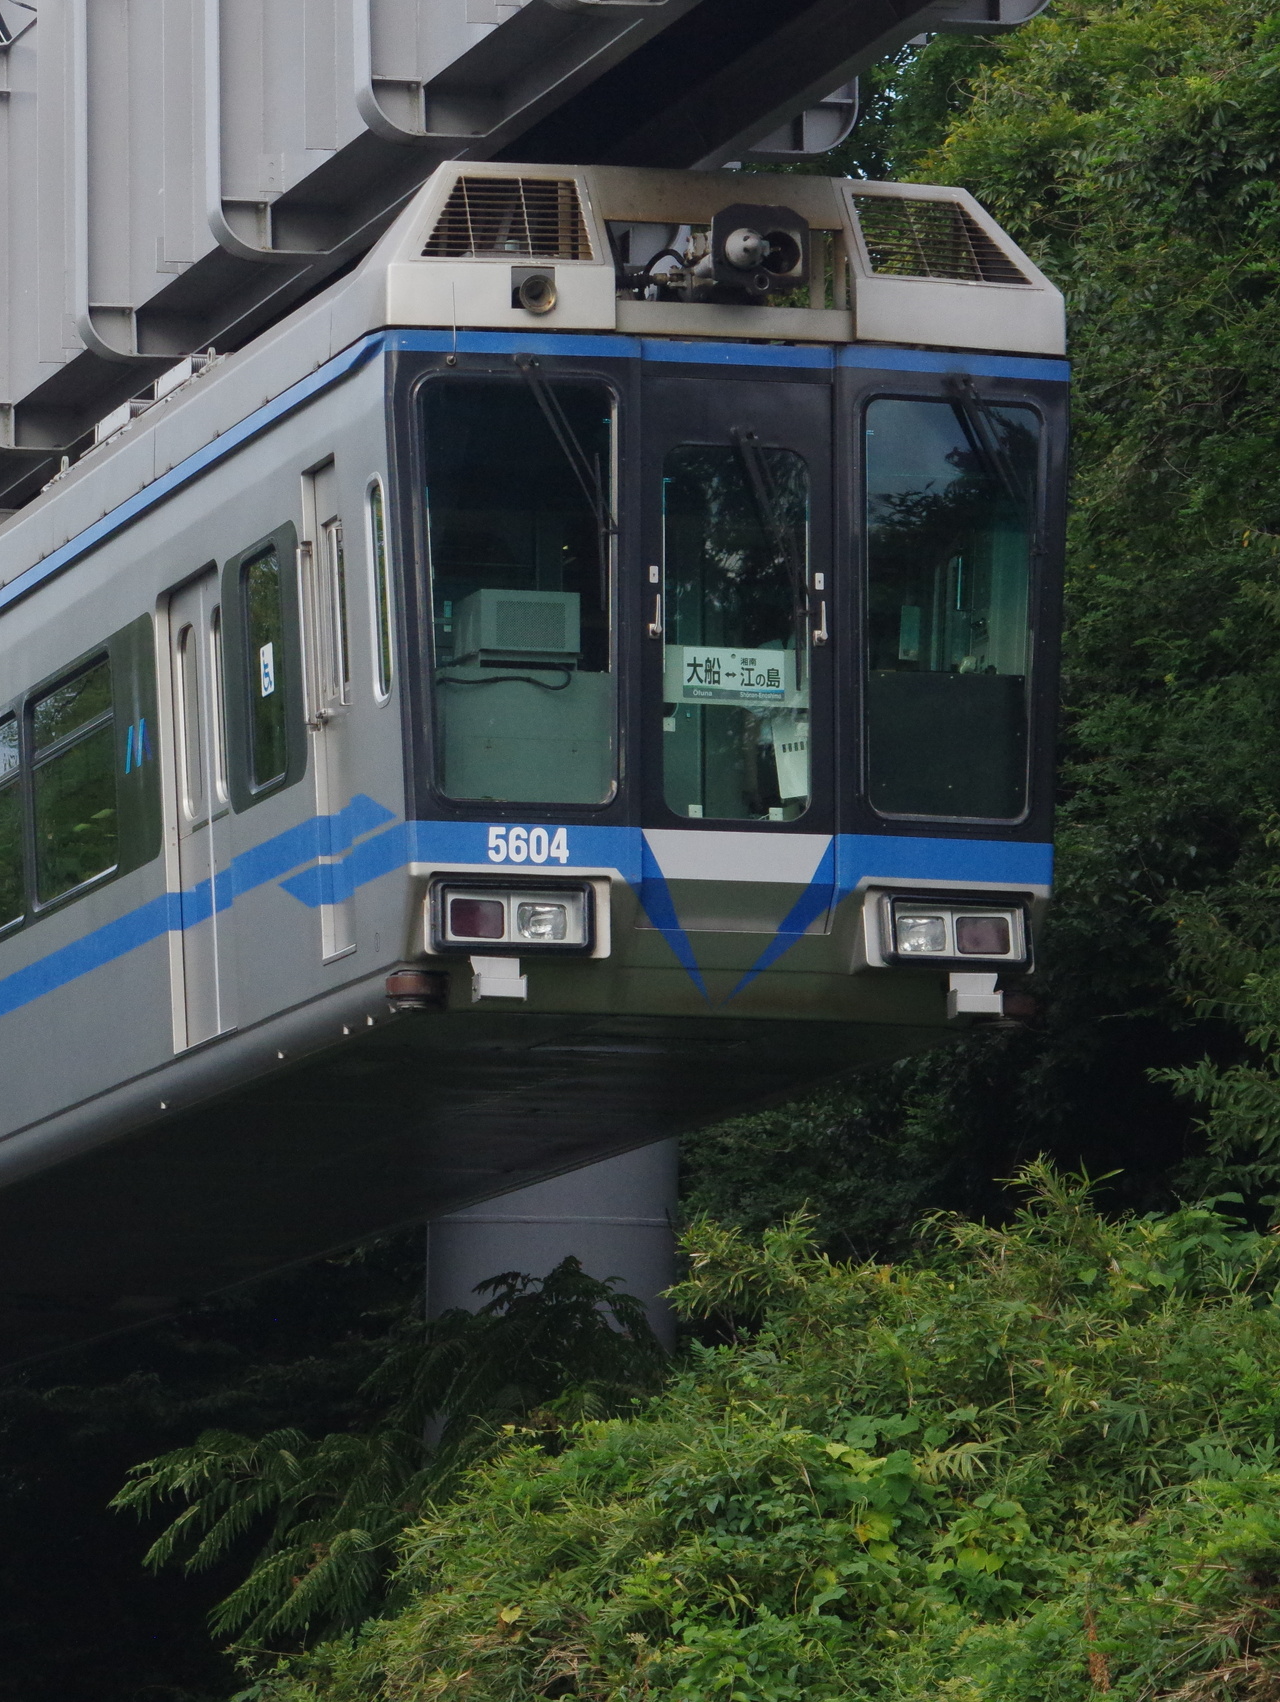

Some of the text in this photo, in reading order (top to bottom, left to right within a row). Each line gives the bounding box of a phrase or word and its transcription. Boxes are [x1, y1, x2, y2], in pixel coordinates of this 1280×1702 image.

[686, 656, 781, 688] 大船 江の島
[740, 657, 757, 666] 湘南
[488, 826, 570, 864] 5604
